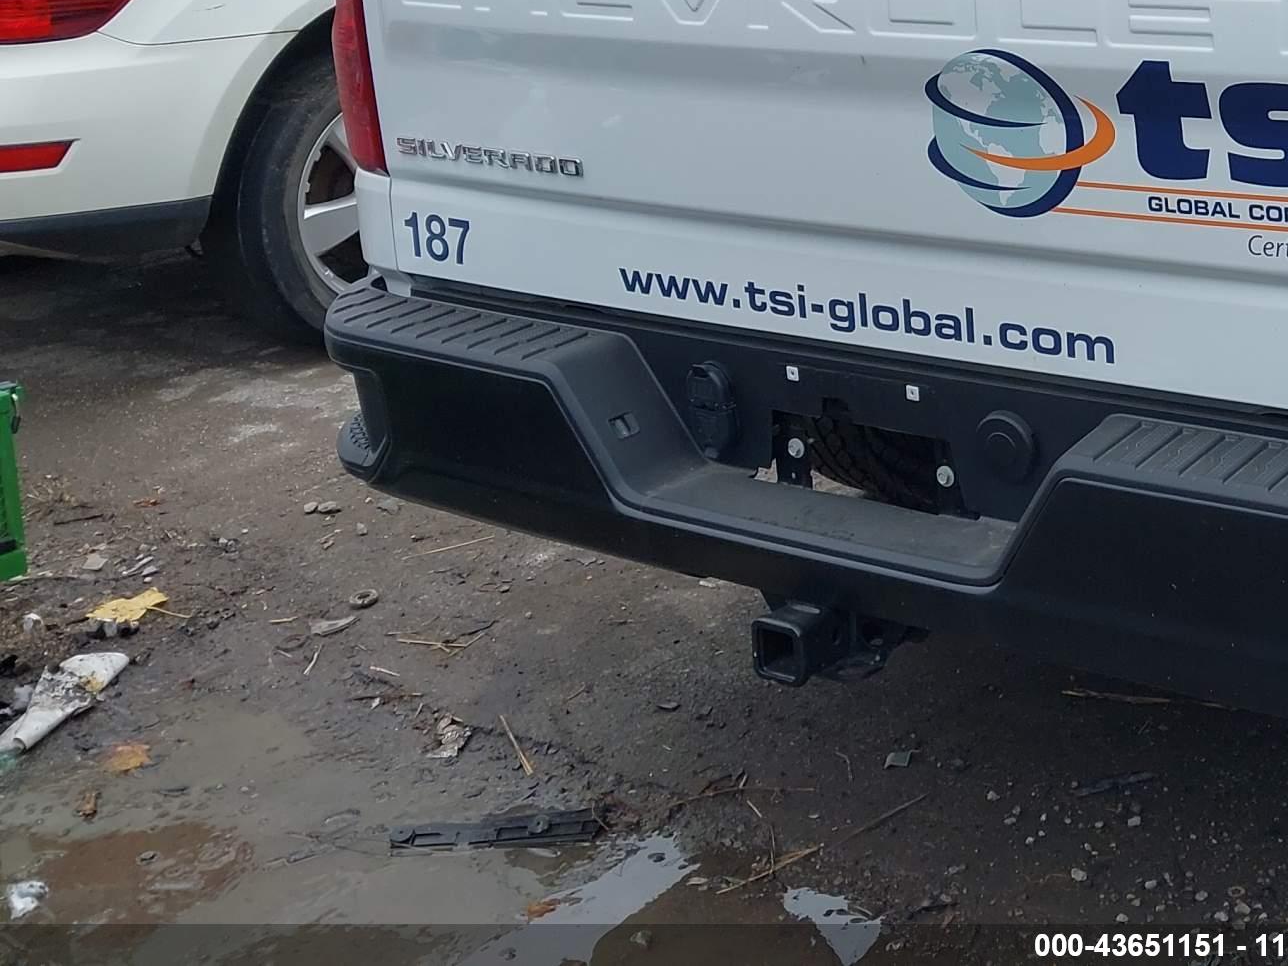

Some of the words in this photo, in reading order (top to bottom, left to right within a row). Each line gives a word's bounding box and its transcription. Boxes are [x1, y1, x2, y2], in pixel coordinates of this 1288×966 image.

[397, 137, 584, 178] SILVERADO
[1148, 196, 1241, 220] GLOBAL
[404, 211, 470, 266] 187
[618, 267, 1117, 365] www.tsi-global.com
